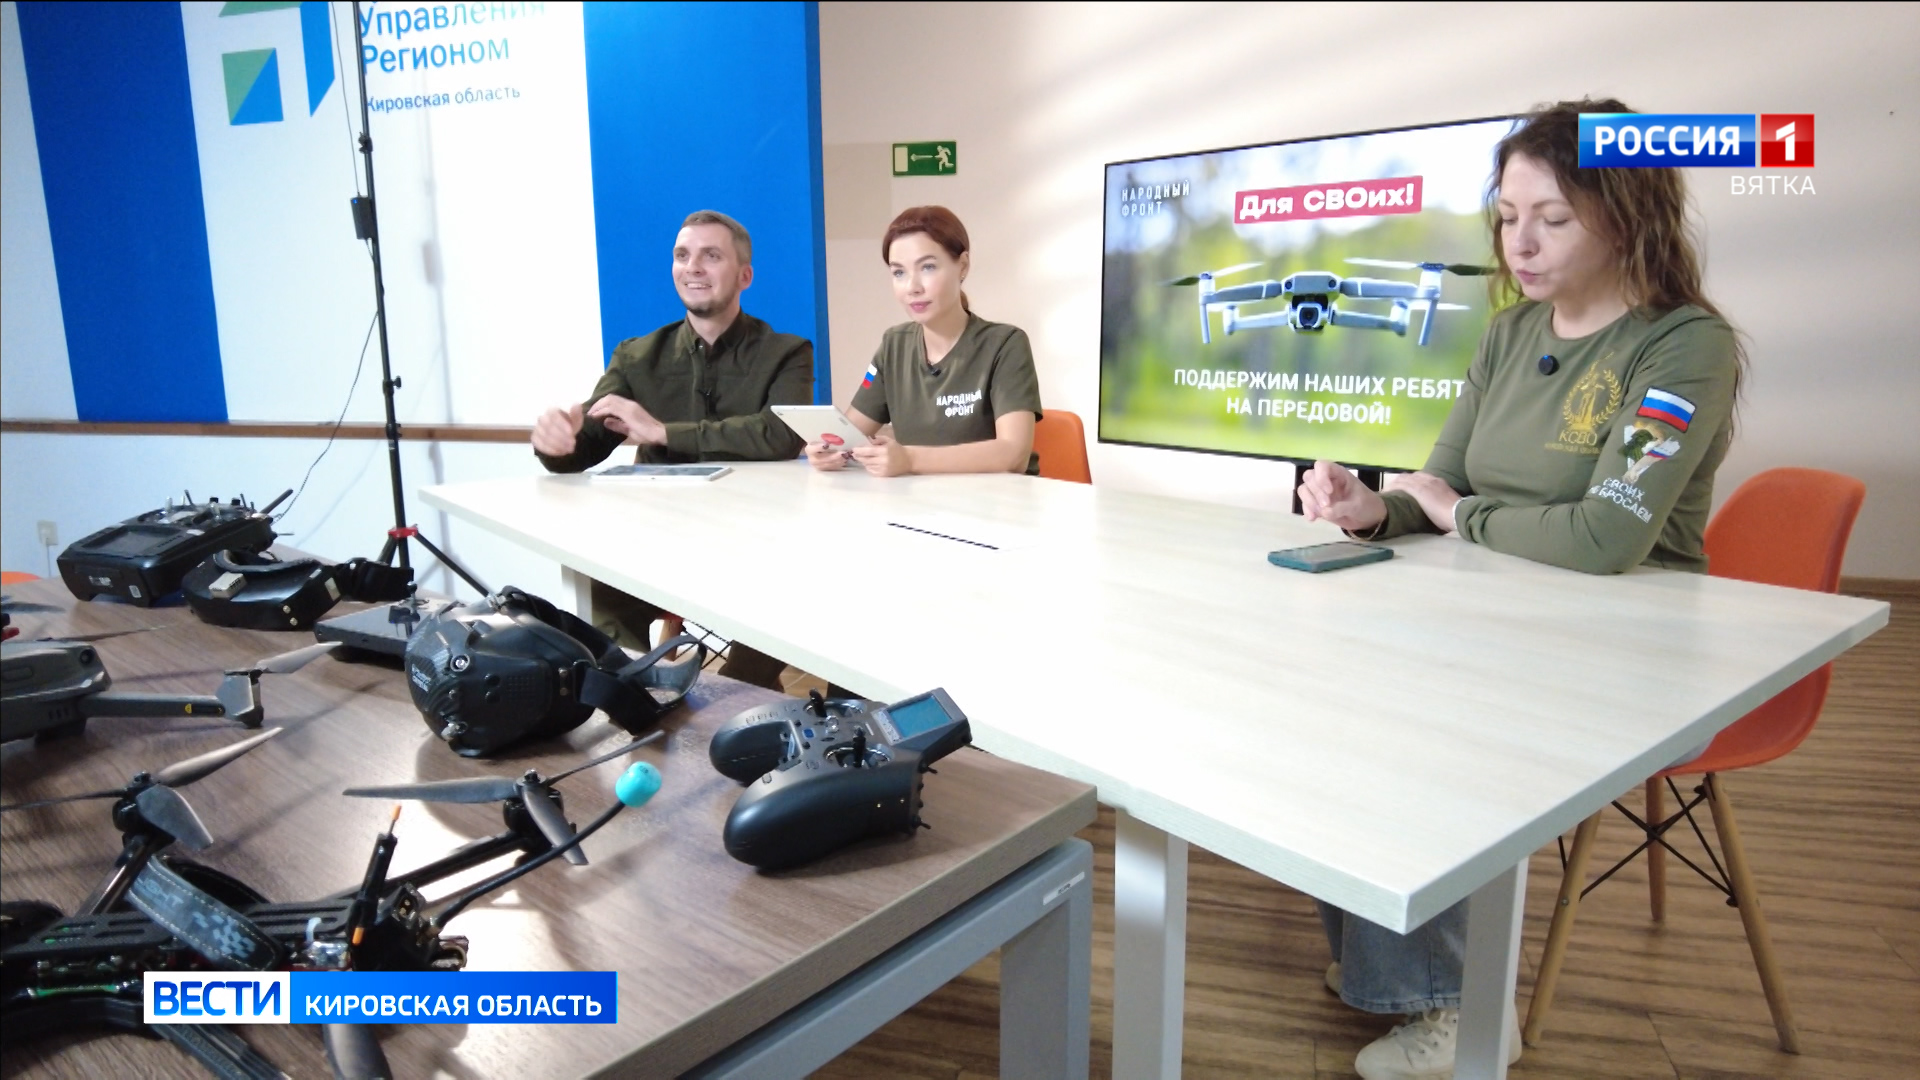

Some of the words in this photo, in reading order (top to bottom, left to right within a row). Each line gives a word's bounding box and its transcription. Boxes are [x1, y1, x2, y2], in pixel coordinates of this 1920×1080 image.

[359, 1, 545, 40] Управления
[362, 38, 510, 76] Регионом
[455, 87, 521, 105] область
[1121, 179, 1190, 202] НАРОДНЫЙ
[1239, 195, 1294, 220] Для
[1303, 183, 1414, 212] СВОих!
[1121, 201, 1162, 217] ФРОНТ
[1174, 369, 1299, 391] ПОДДЕРЖИМ
[1304, 373, 1386, 396] НАШИХ
[1391, 377, 1466, 399] РЕБЯТ
[936, 388, 982, 406] НАРОДНЫЙ
[944, 403, 975, 418] ФРОНТ
[1226, 397, 1252, 416] НА
[1257, 399, 1391, 425] ПЕРЕДОВОЙ!
